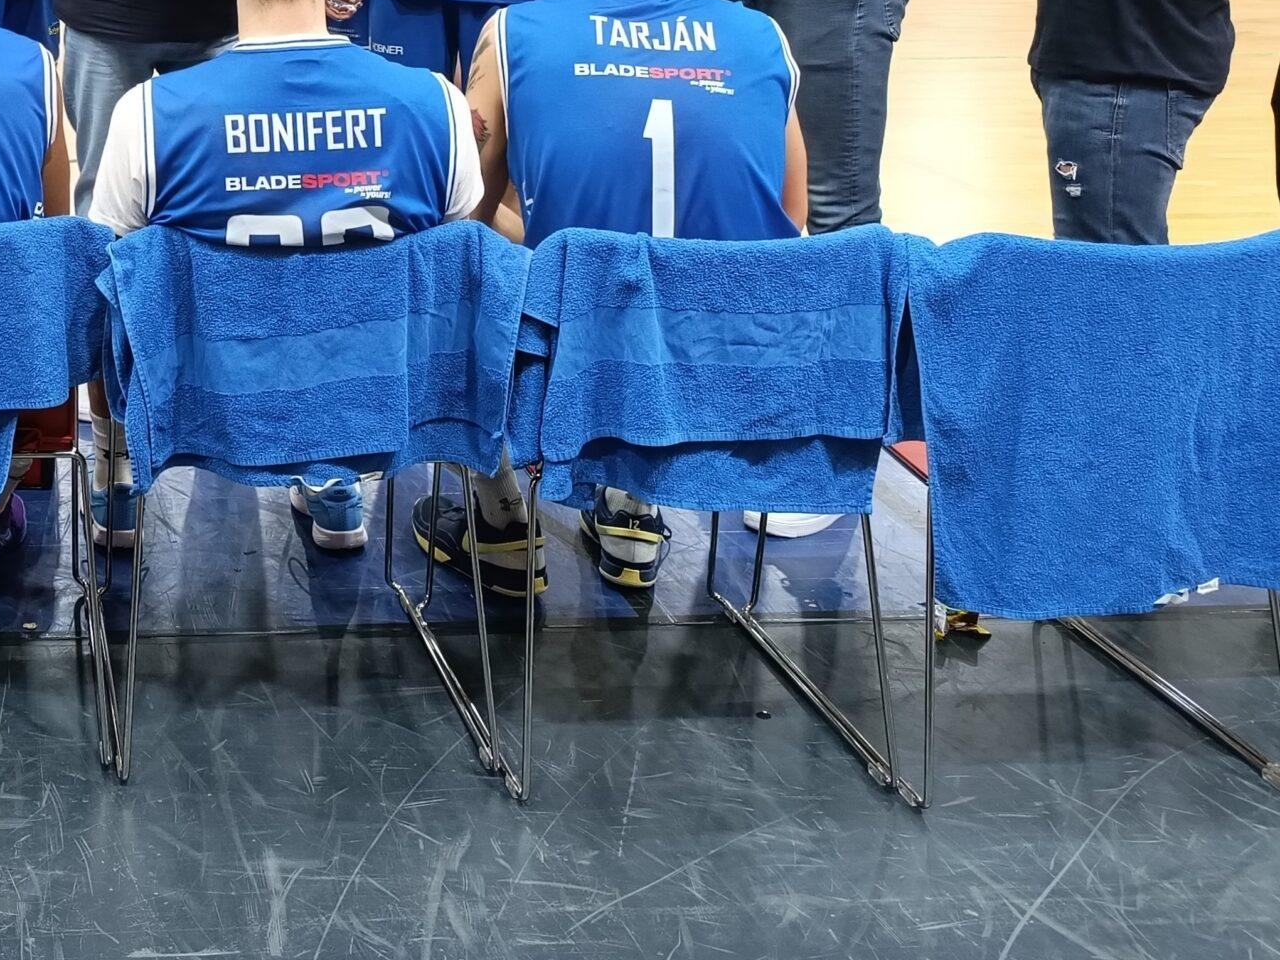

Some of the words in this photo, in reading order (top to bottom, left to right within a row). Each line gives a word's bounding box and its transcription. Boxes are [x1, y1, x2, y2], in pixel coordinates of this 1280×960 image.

[589, 15, 717, 52] TARJÁN
[224, 107, 387, 154] BONIFERT
[642, 98, 675, 239] 1
[629, 518, 640, 530] 12
